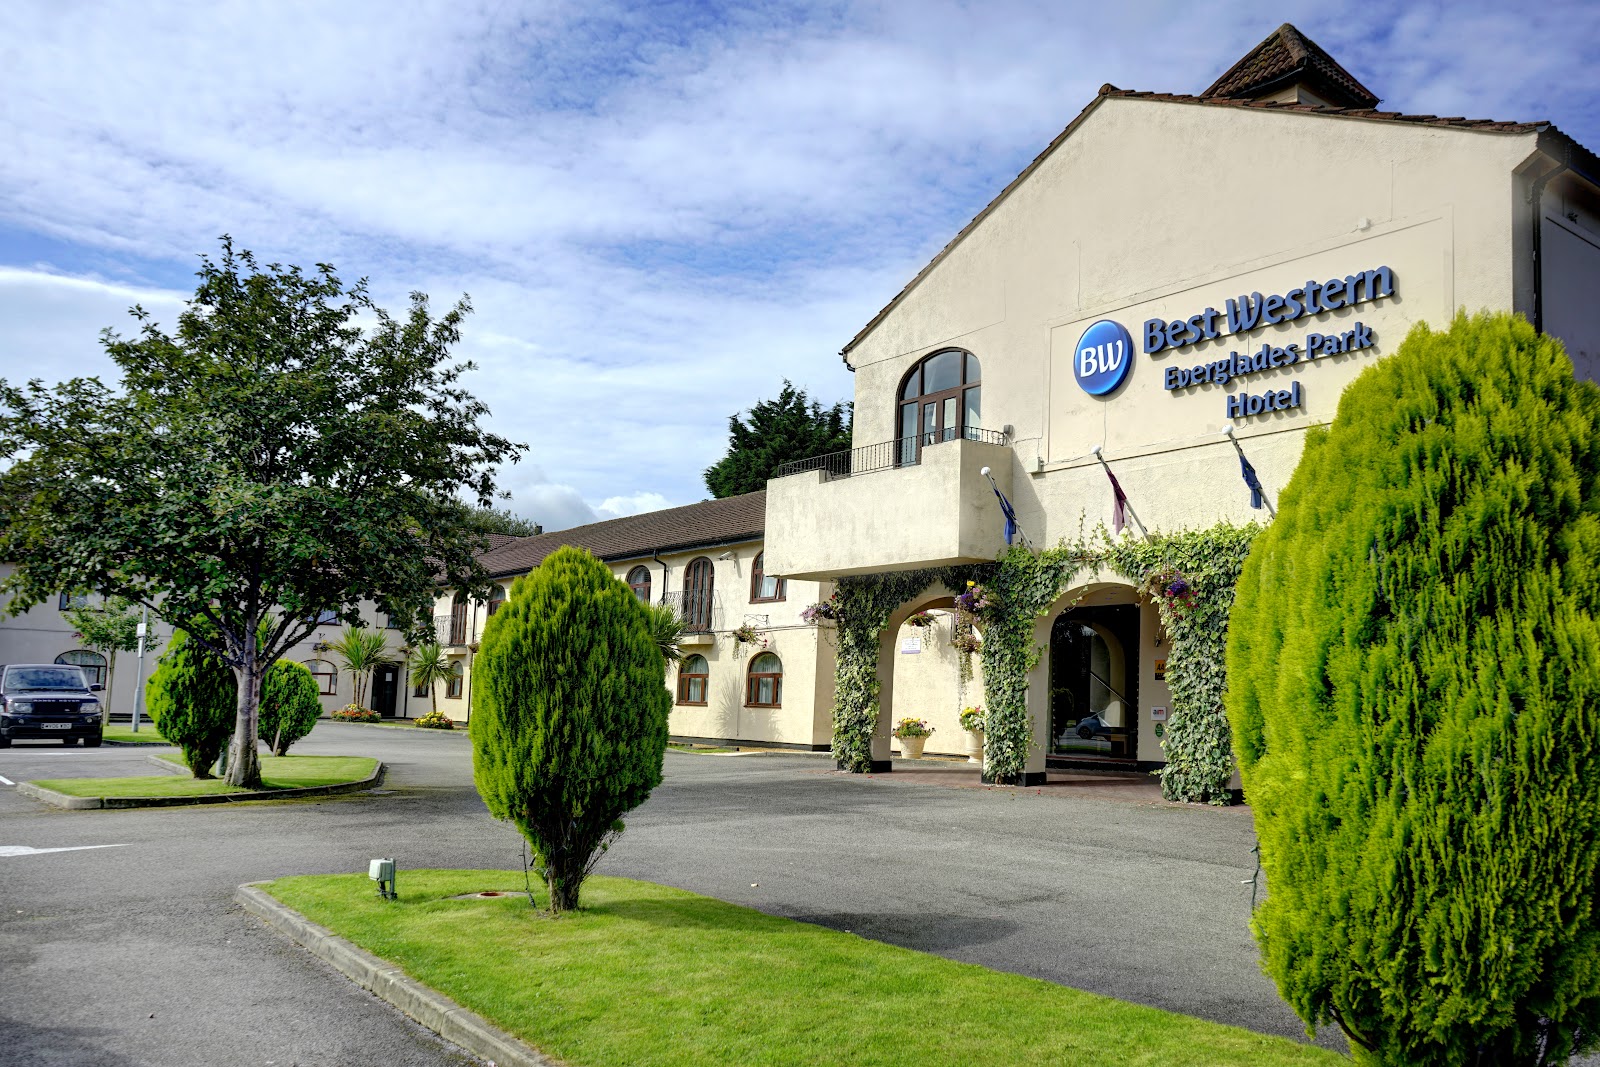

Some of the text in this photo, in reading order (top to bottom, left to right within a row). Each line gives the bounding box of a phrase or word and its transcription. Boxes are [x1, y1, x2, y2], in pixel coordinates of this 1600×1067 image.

[1144, 265, 1395, 353] Best Western
[1080, 339, 1123, 377] BW
[1164, 321, 1374, 391] Everglades Park
[1226, 380, 1301, 419] Hotel
